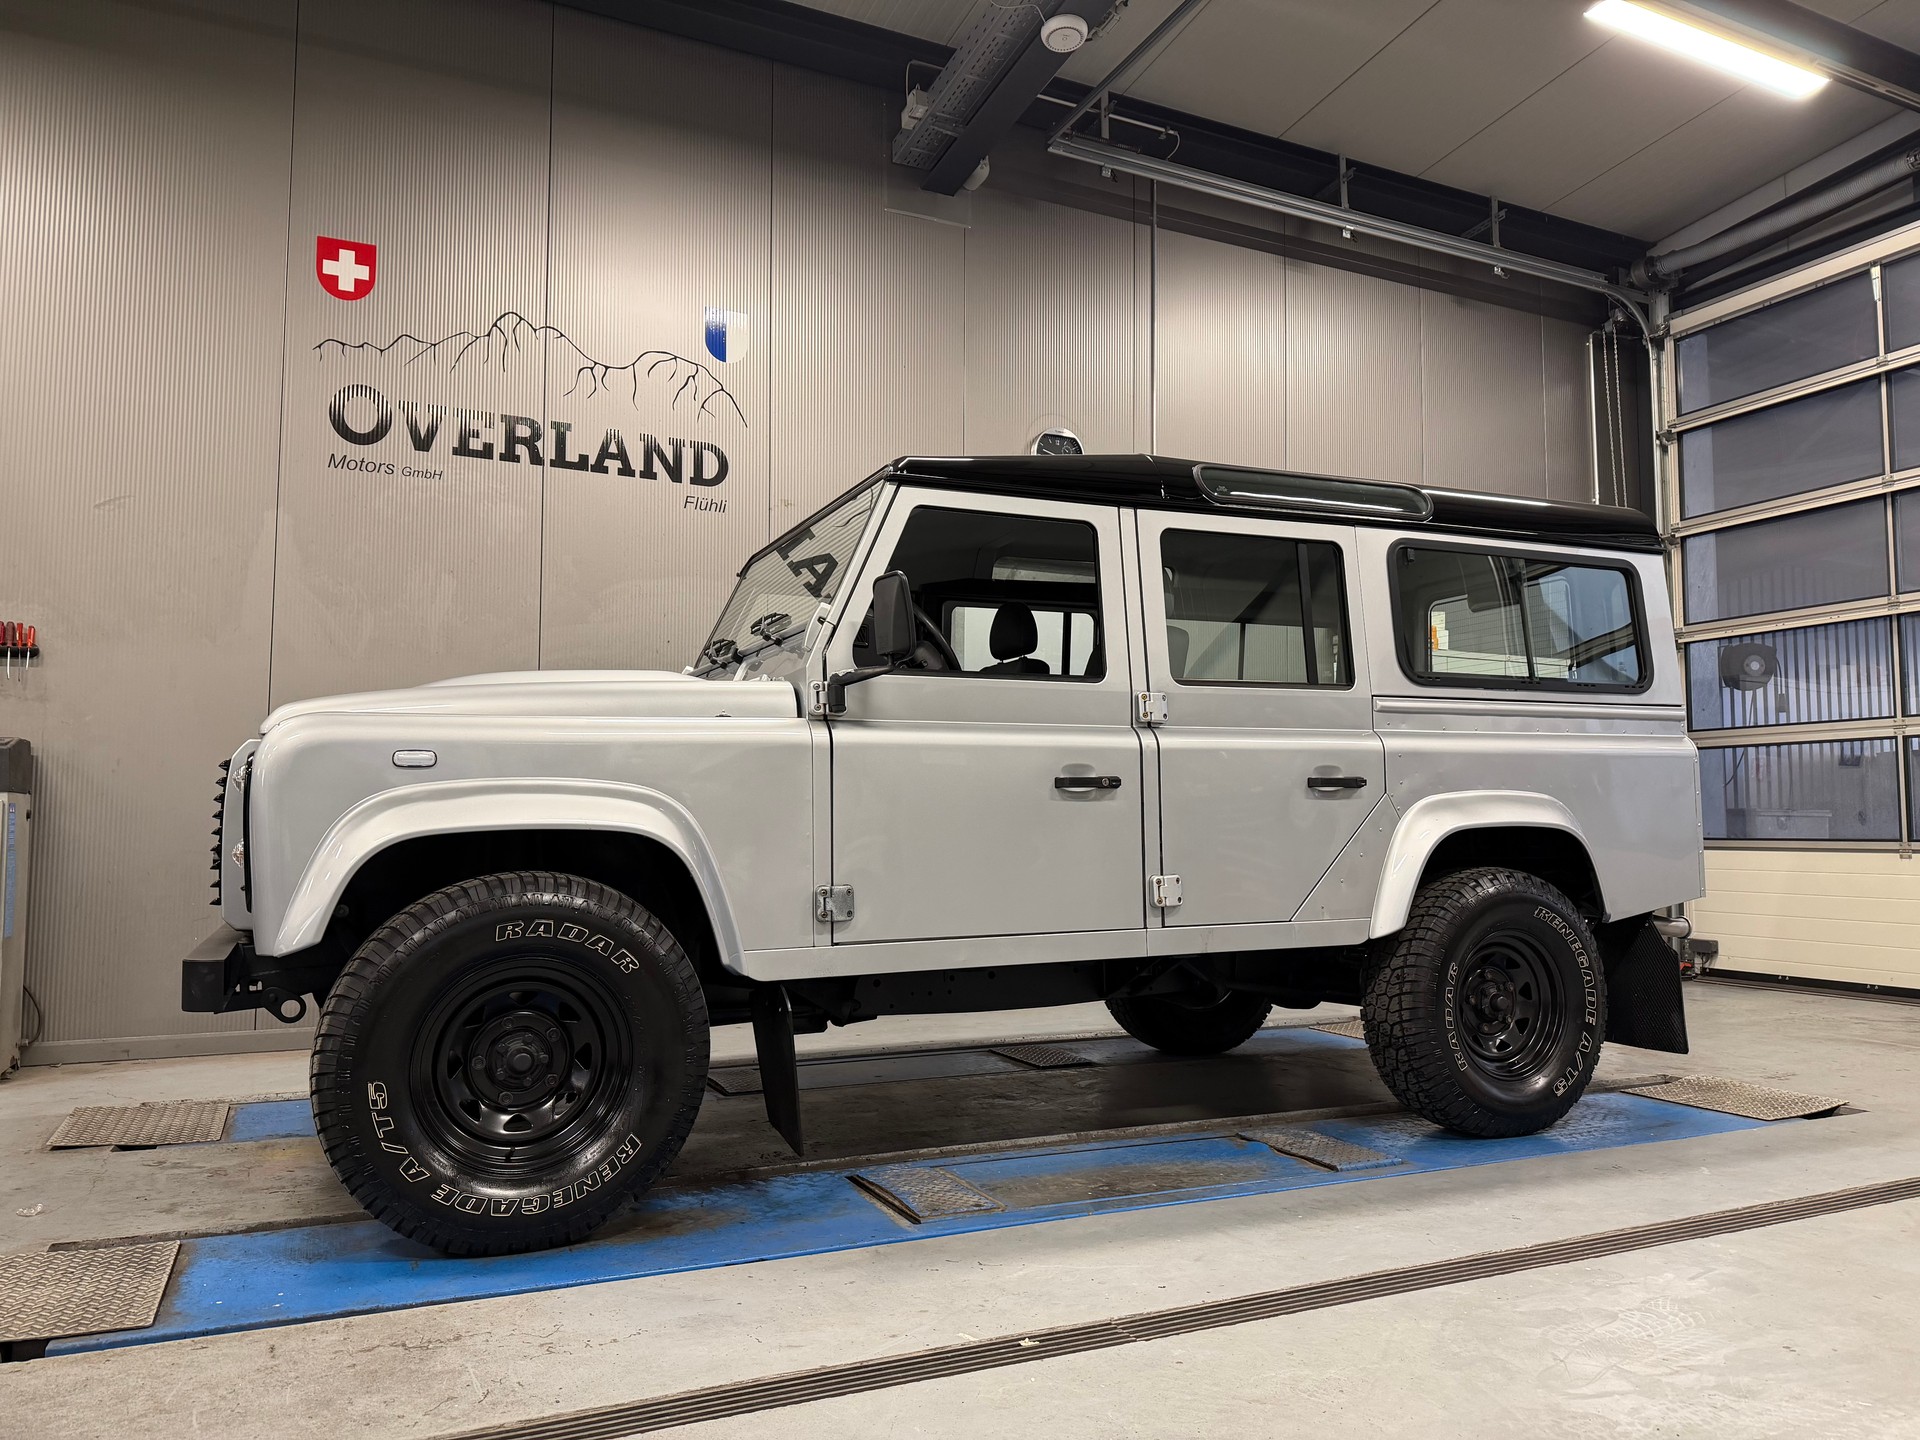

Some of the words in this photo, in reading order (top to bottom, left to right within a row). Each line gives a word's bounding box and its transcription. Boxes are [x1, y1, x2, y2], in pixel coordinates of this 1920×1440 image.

[328, 453, 395, 475] Motors
[401, 466, 443, 480] GmbH
[329, 384, 729, 487] OVERLAND
[684, 495, 727, 513] Flühli
[495, 919, 640, 974] RADAR
[1533, 906, 1598, 1026] RENEGADE
[1445, 962, 1468, 1071] RADAR
[431, 1134, 643, 1217] RENEGADE
